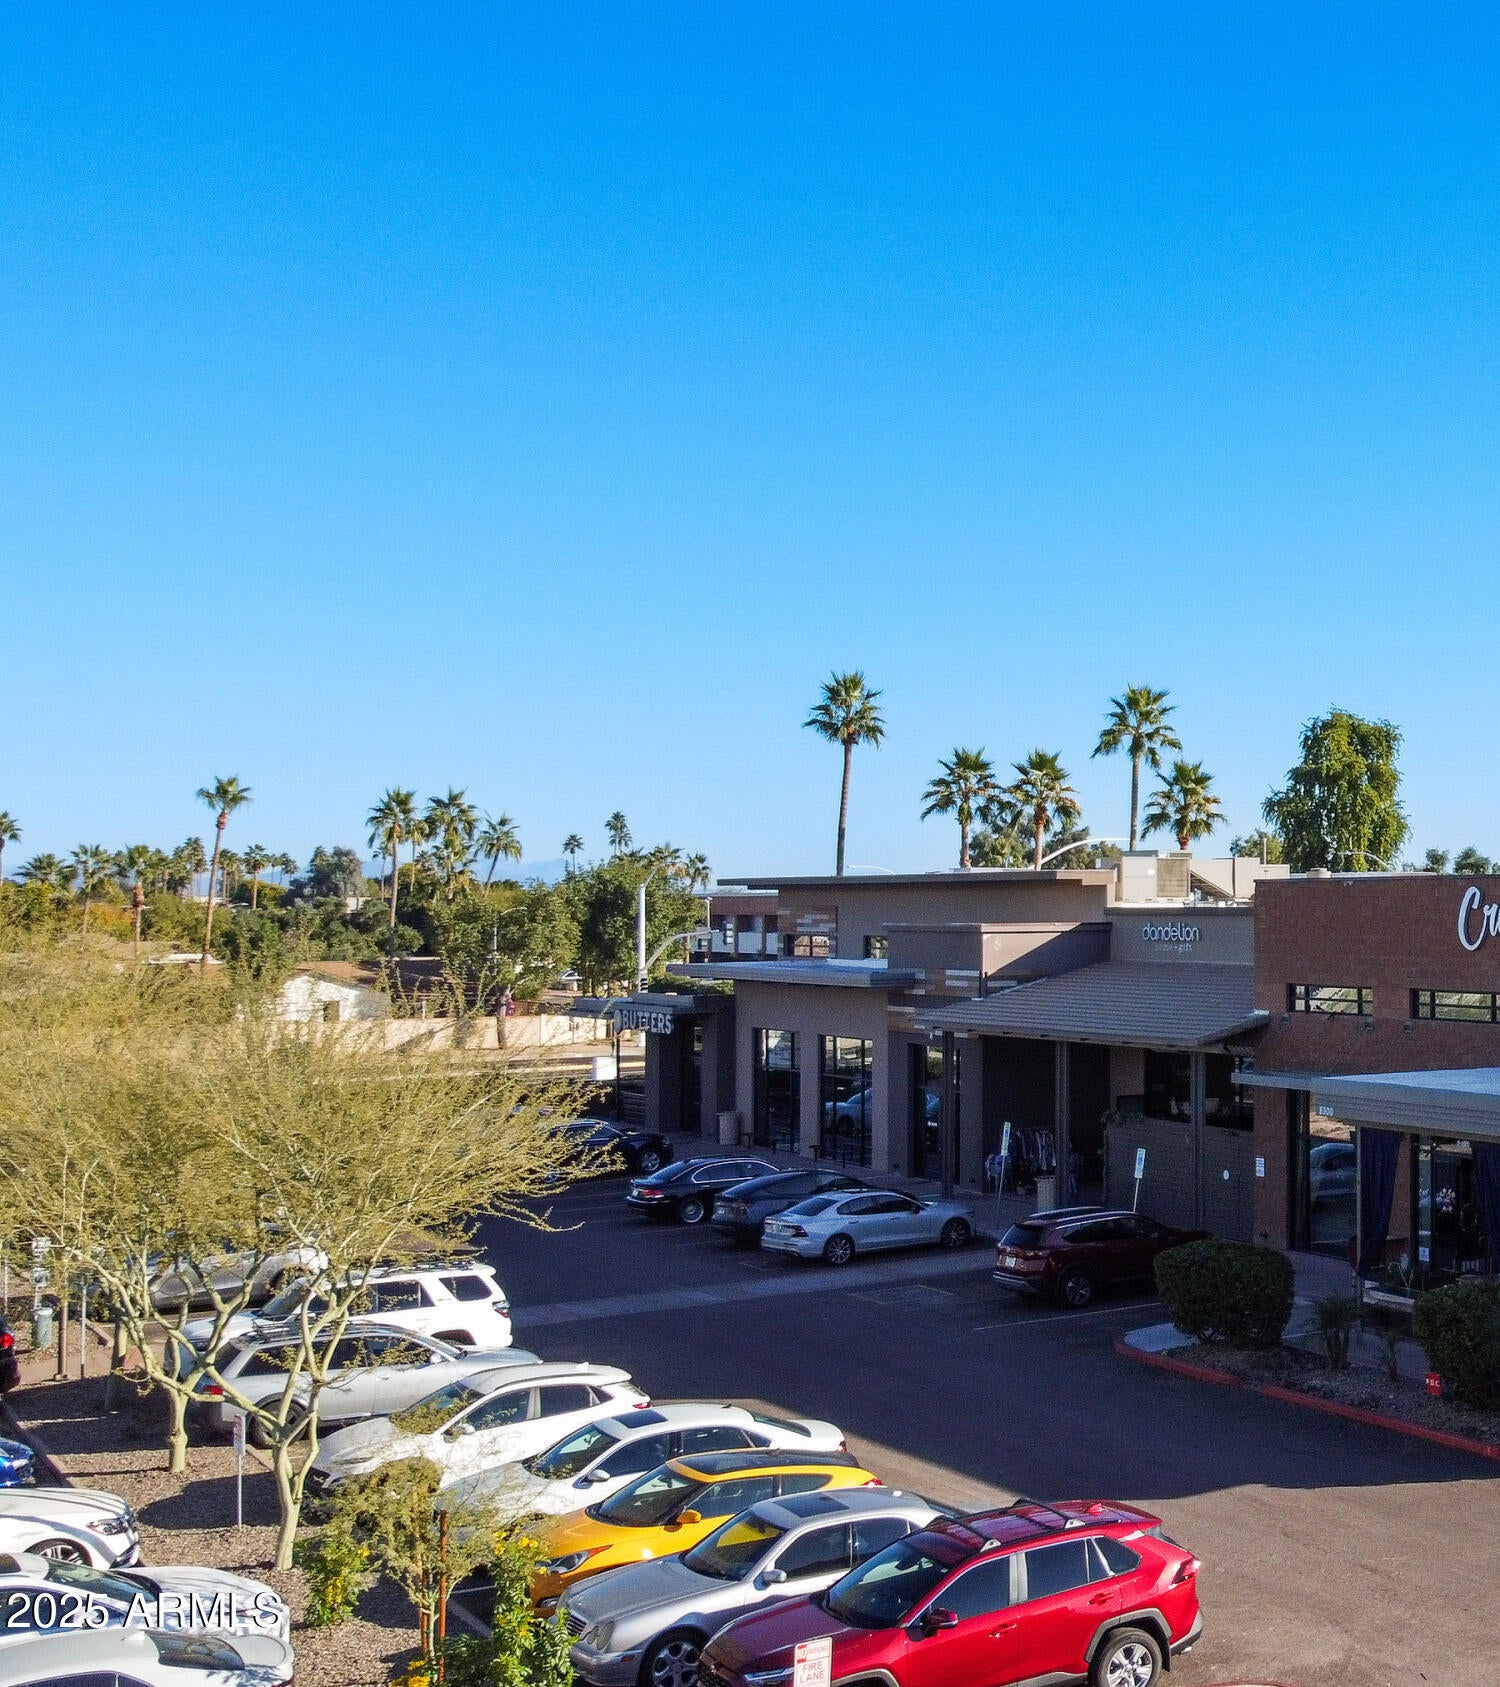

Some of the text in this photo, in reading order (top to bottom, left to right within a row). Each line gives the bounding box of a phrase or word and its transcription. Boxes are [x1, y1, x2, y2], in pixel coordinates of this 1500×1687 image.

[1142, 922, 1199, 941] dandelion
[622, 1009, 672, 1035] BUTTERS
[803, 1660, 823, 1673] FIRE
[799, 1670, 825, 1684] LANE
